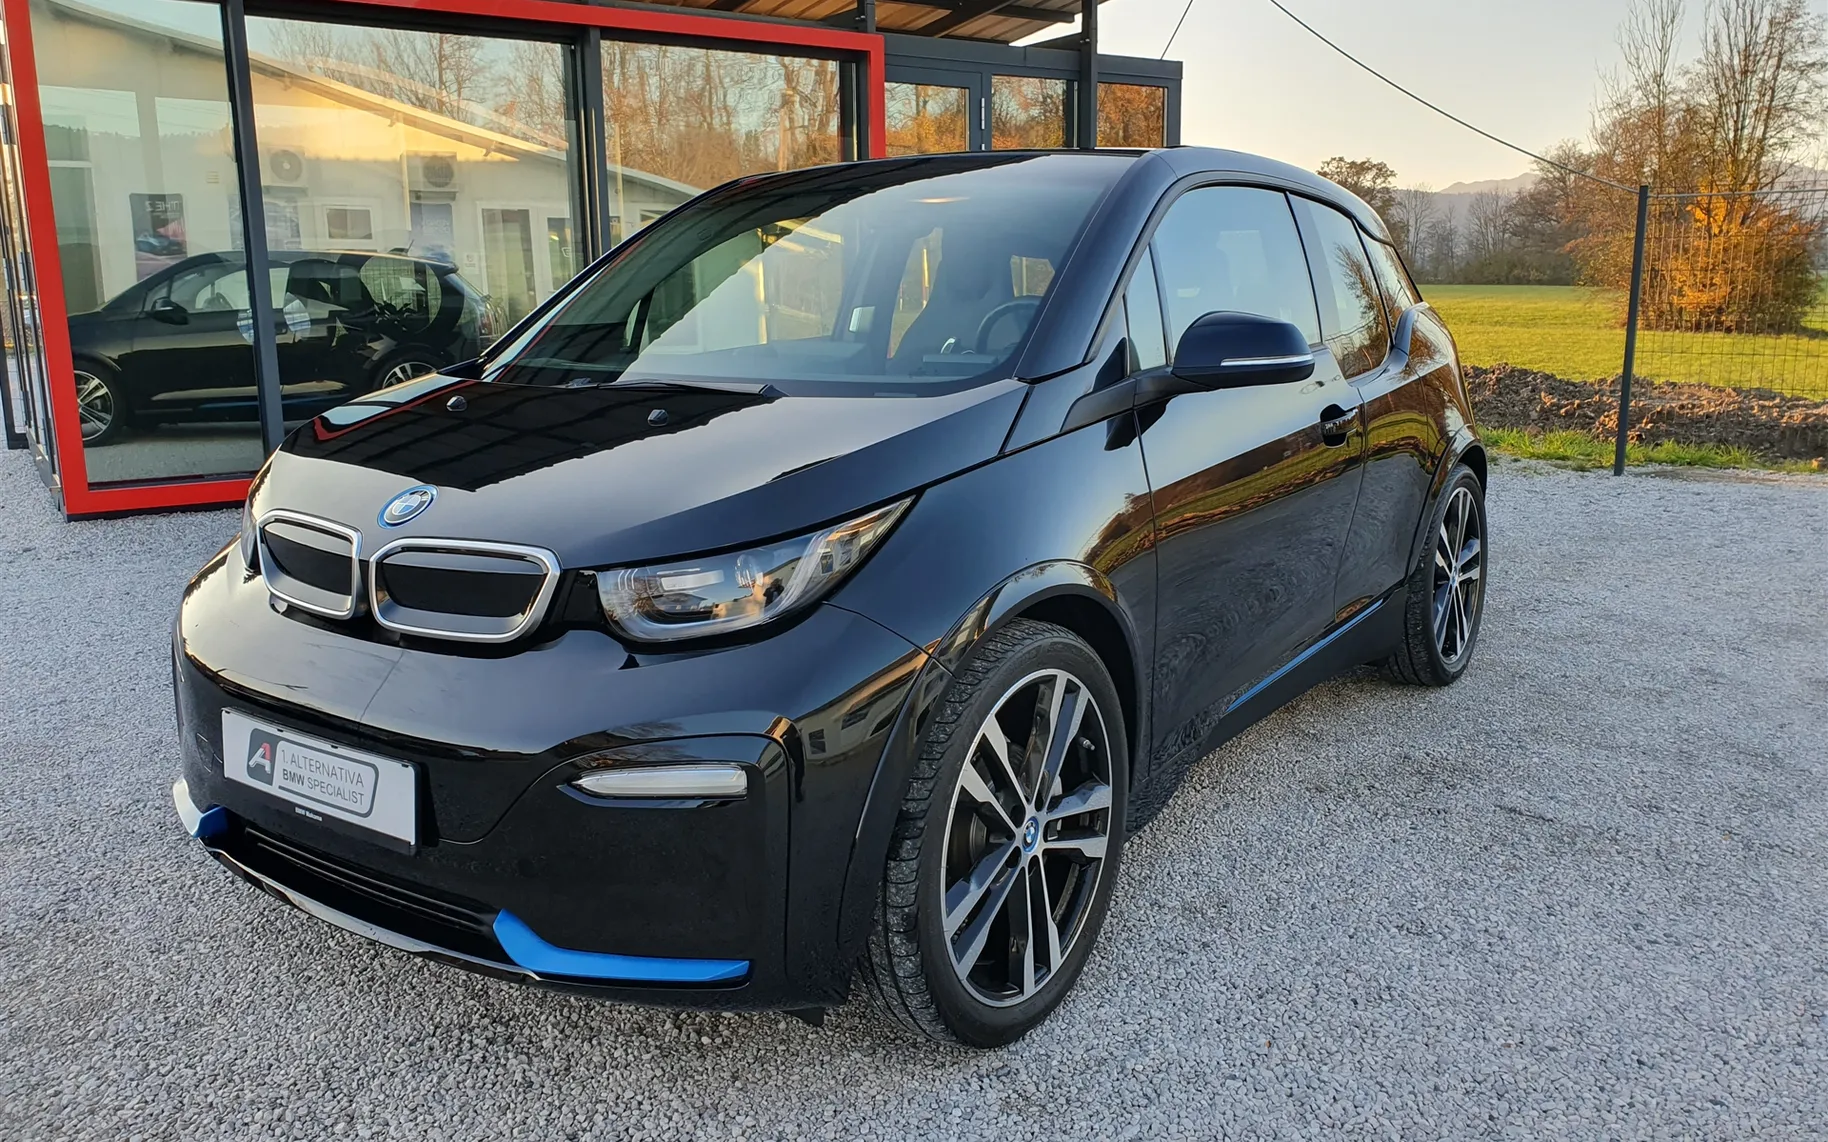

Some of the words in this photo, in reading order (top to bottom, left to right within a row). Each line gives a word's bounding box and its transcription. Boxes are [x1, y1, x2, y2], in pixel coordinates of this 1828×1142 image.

[282, 768, 305, 787] BMW
[307, 778, 365, 806] SPECIALIST
[291, 755, 365, 788] ALTERNATIVA
